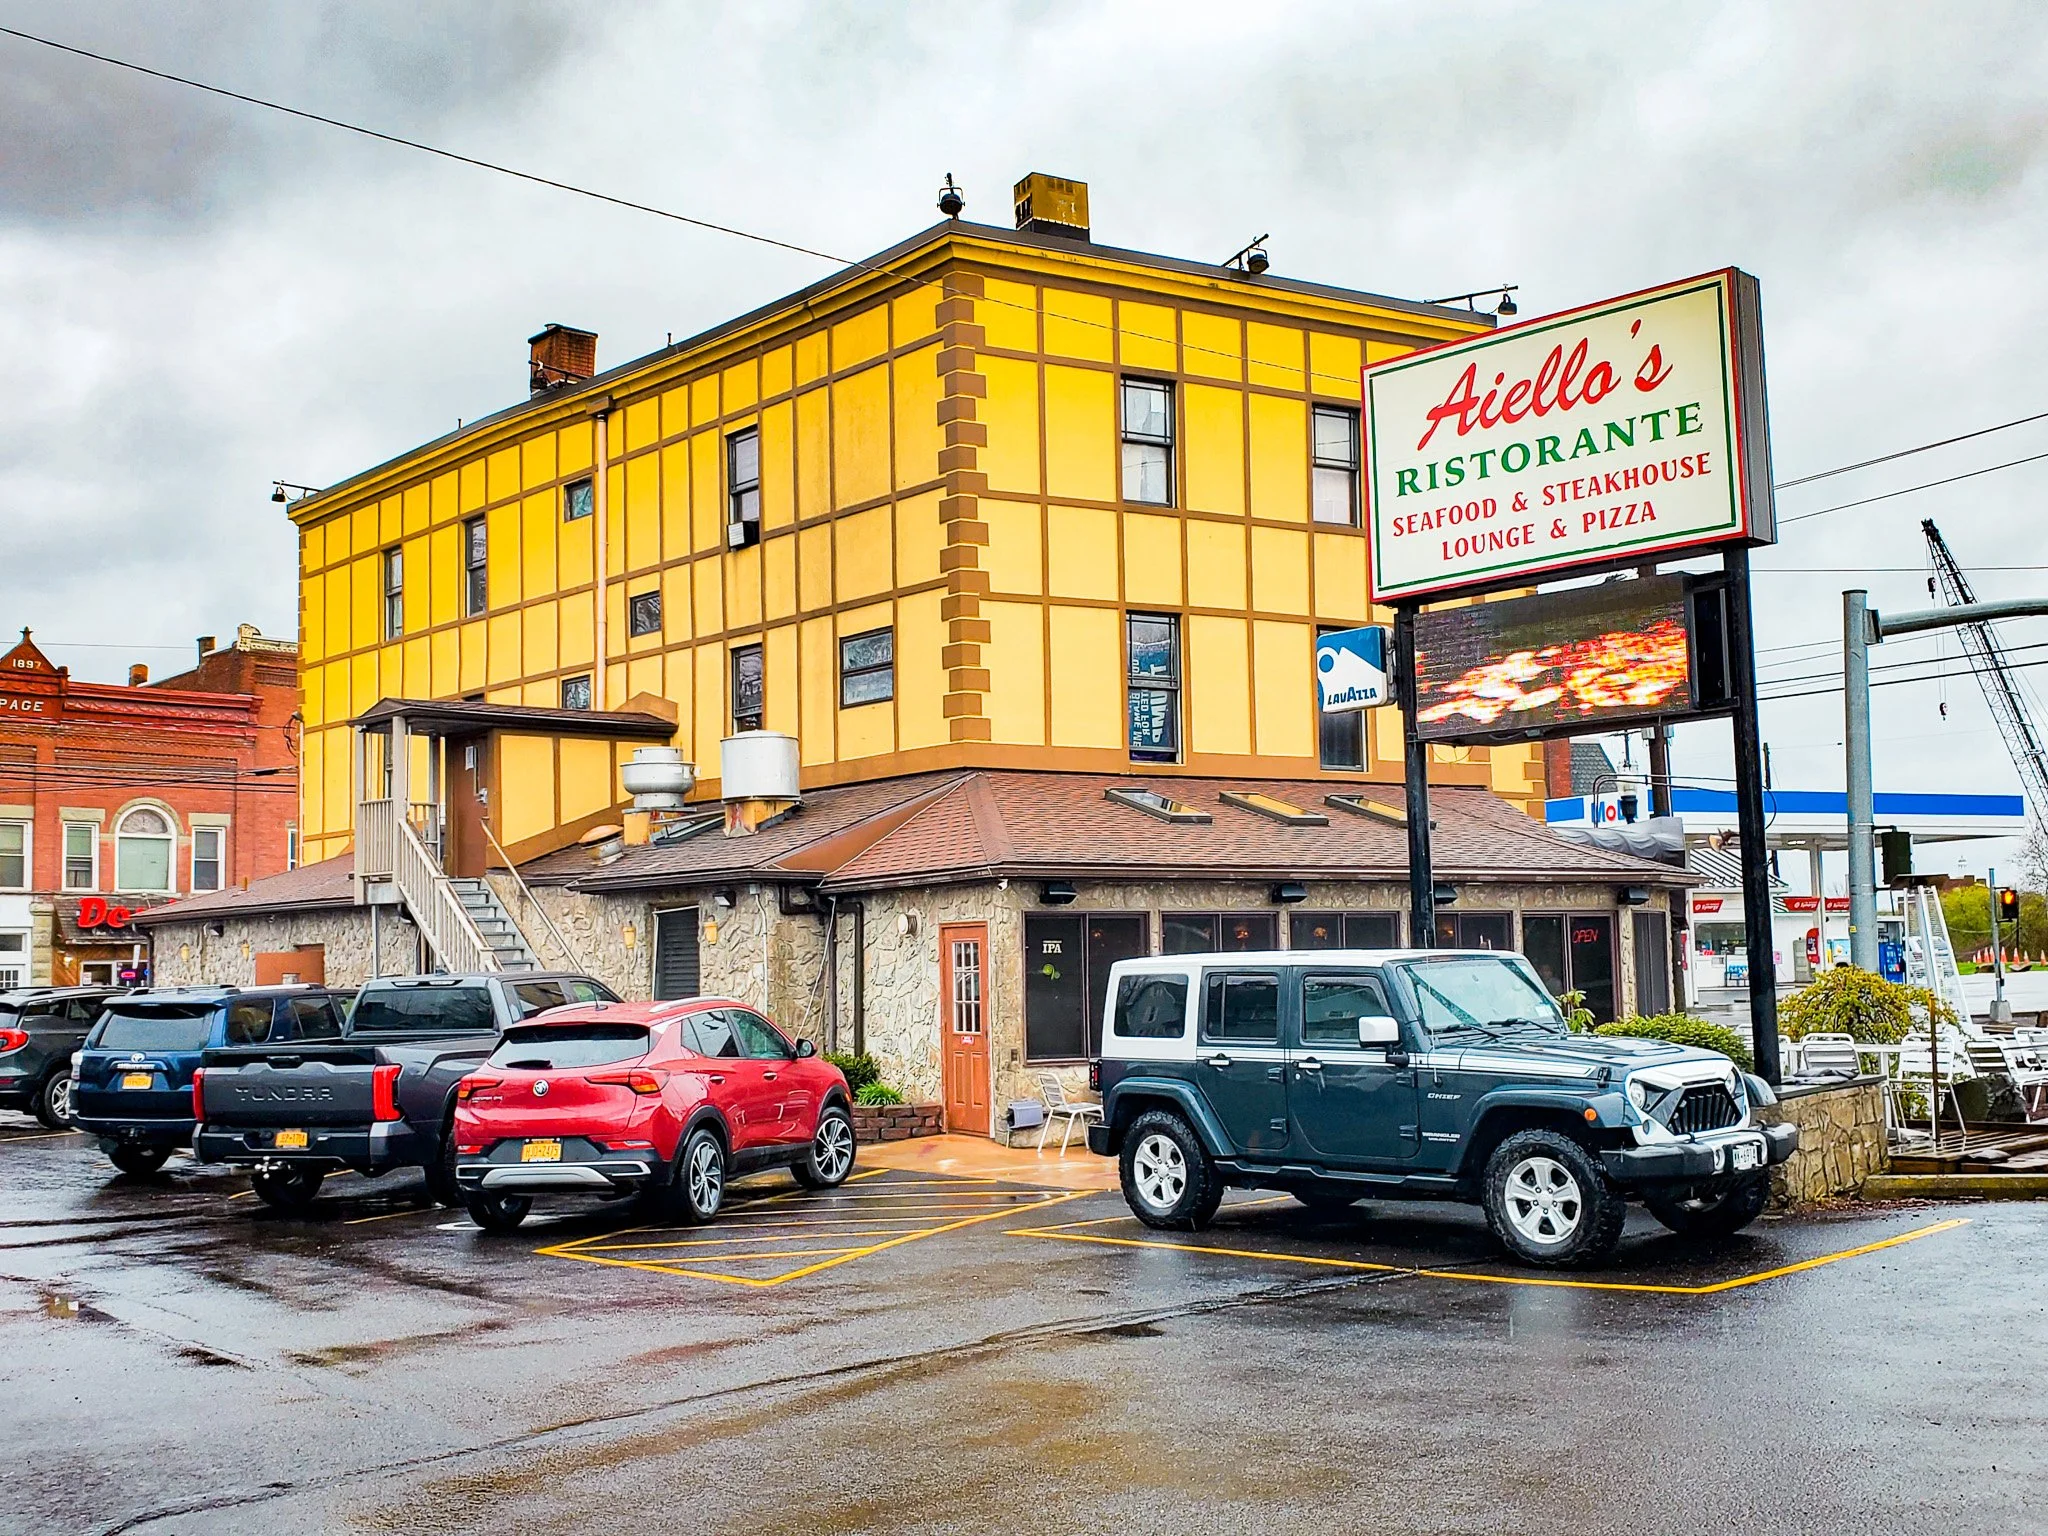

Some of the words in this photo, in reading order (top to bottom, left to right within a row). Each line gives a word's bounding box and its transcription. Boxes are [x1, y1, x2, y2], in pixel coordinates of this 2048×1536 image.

[1417, 319, 1674, 451] Aiello's
[1396, 402, 1704, 498] RISTORANTE
[1393, 497, 1497, 537] SEAFOOD
[1511, 491, 1529, 512] &
[1542, 452, 1712, 506] STEAKHOUSE
[1442, 523, 1536, 561] LOUNGE
[1550, 518, 1567, 539] &
[1582, 500, 1657, 534] PIZZA
[12, 658, 42, 669] 1897
[1327, 686, 1378, 705] LAVAZZA
[0, 698, 44, 712] PAGE
[1572, 928, 1599, 944] OPEN
[1042, 943, 1062, 954] IPA
[235, 1087, 334, 1101] TUNDRA
